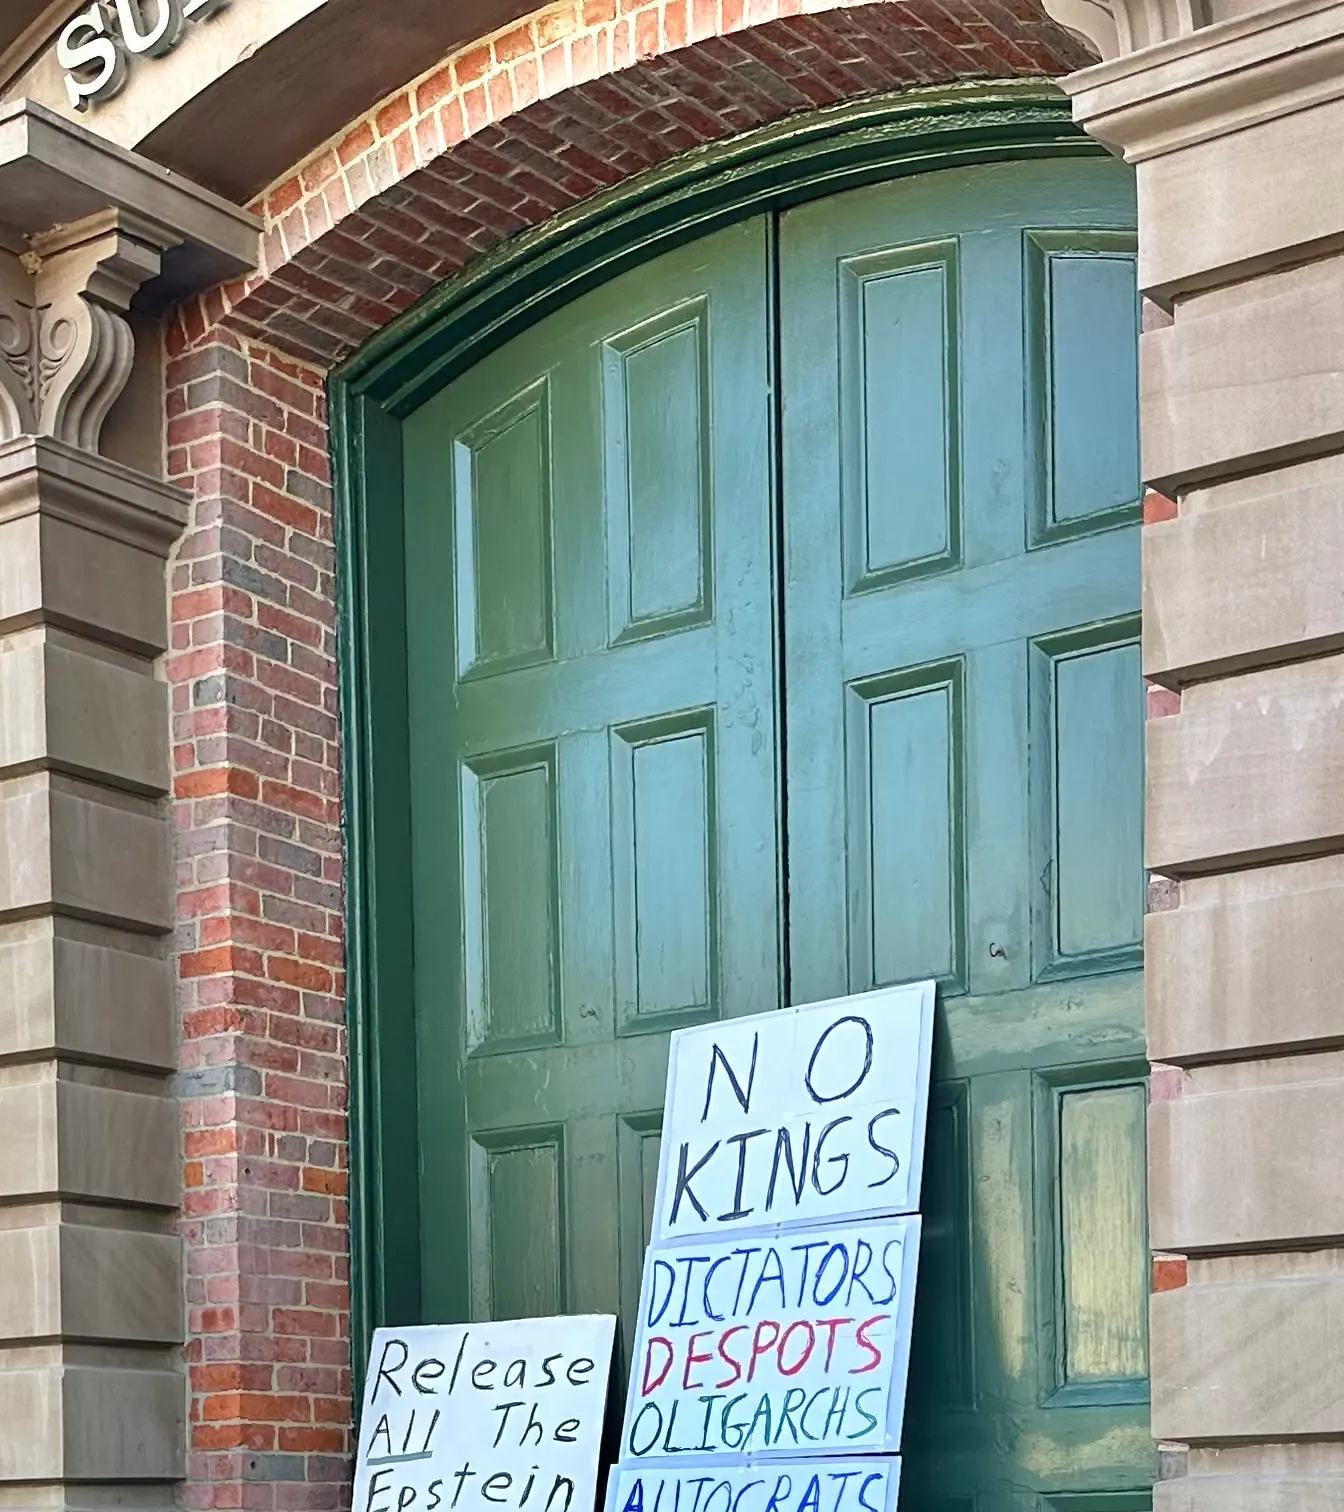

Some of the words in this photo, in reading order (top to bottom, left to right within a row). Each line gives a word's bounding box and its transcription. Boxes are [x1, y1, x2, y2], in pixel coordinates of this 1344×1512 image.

[701, 1015, 875, 1122] NO
[667, 1106, 902, 1227] KINGS
[646, 1239, 902, 1328] DICTATORS
[370, 1332, 596, 1403] Release
[641, 1314, 891, 1398] DESPOTS
[369, 1408, 441, 1460] All
[492, 1401, 583, 1449] The
[629, 1385, 880, 1456] OLIGARCHS
